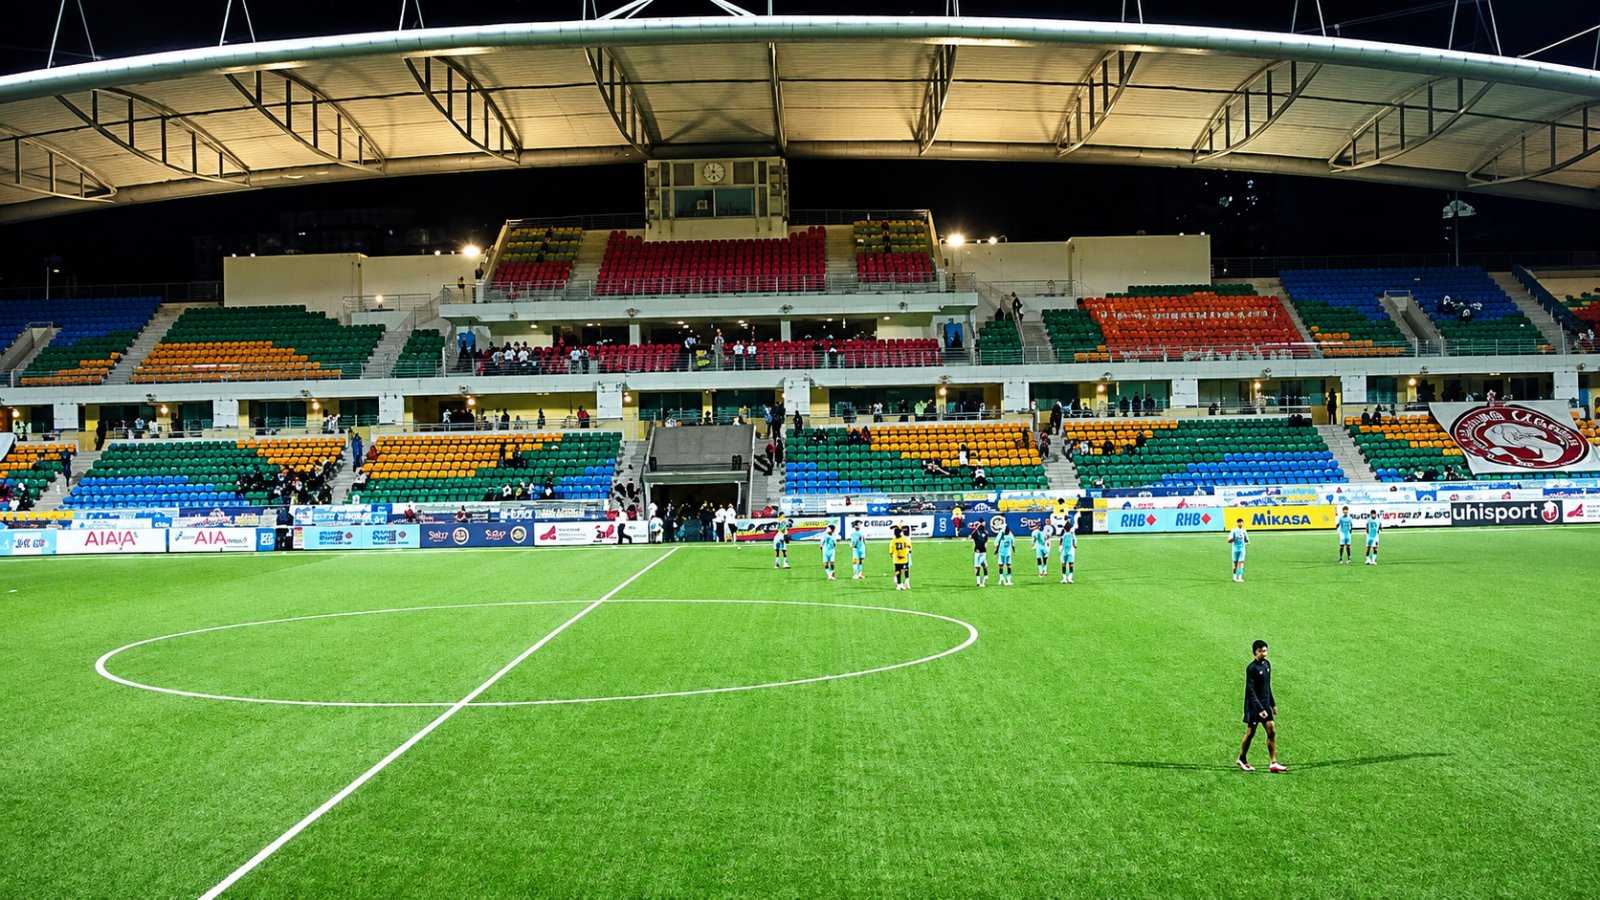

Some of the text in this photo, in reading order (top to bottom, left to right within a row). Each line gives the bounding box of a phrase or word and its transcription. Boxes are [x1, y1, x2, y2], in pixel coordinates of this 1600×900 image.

[1120, 513, 1146, 528] RHB
[1175, 512, 1201, 527] RHB
[1452, 502, 1538, 524] uhisport
[194, 530, 227, 545] AIA
